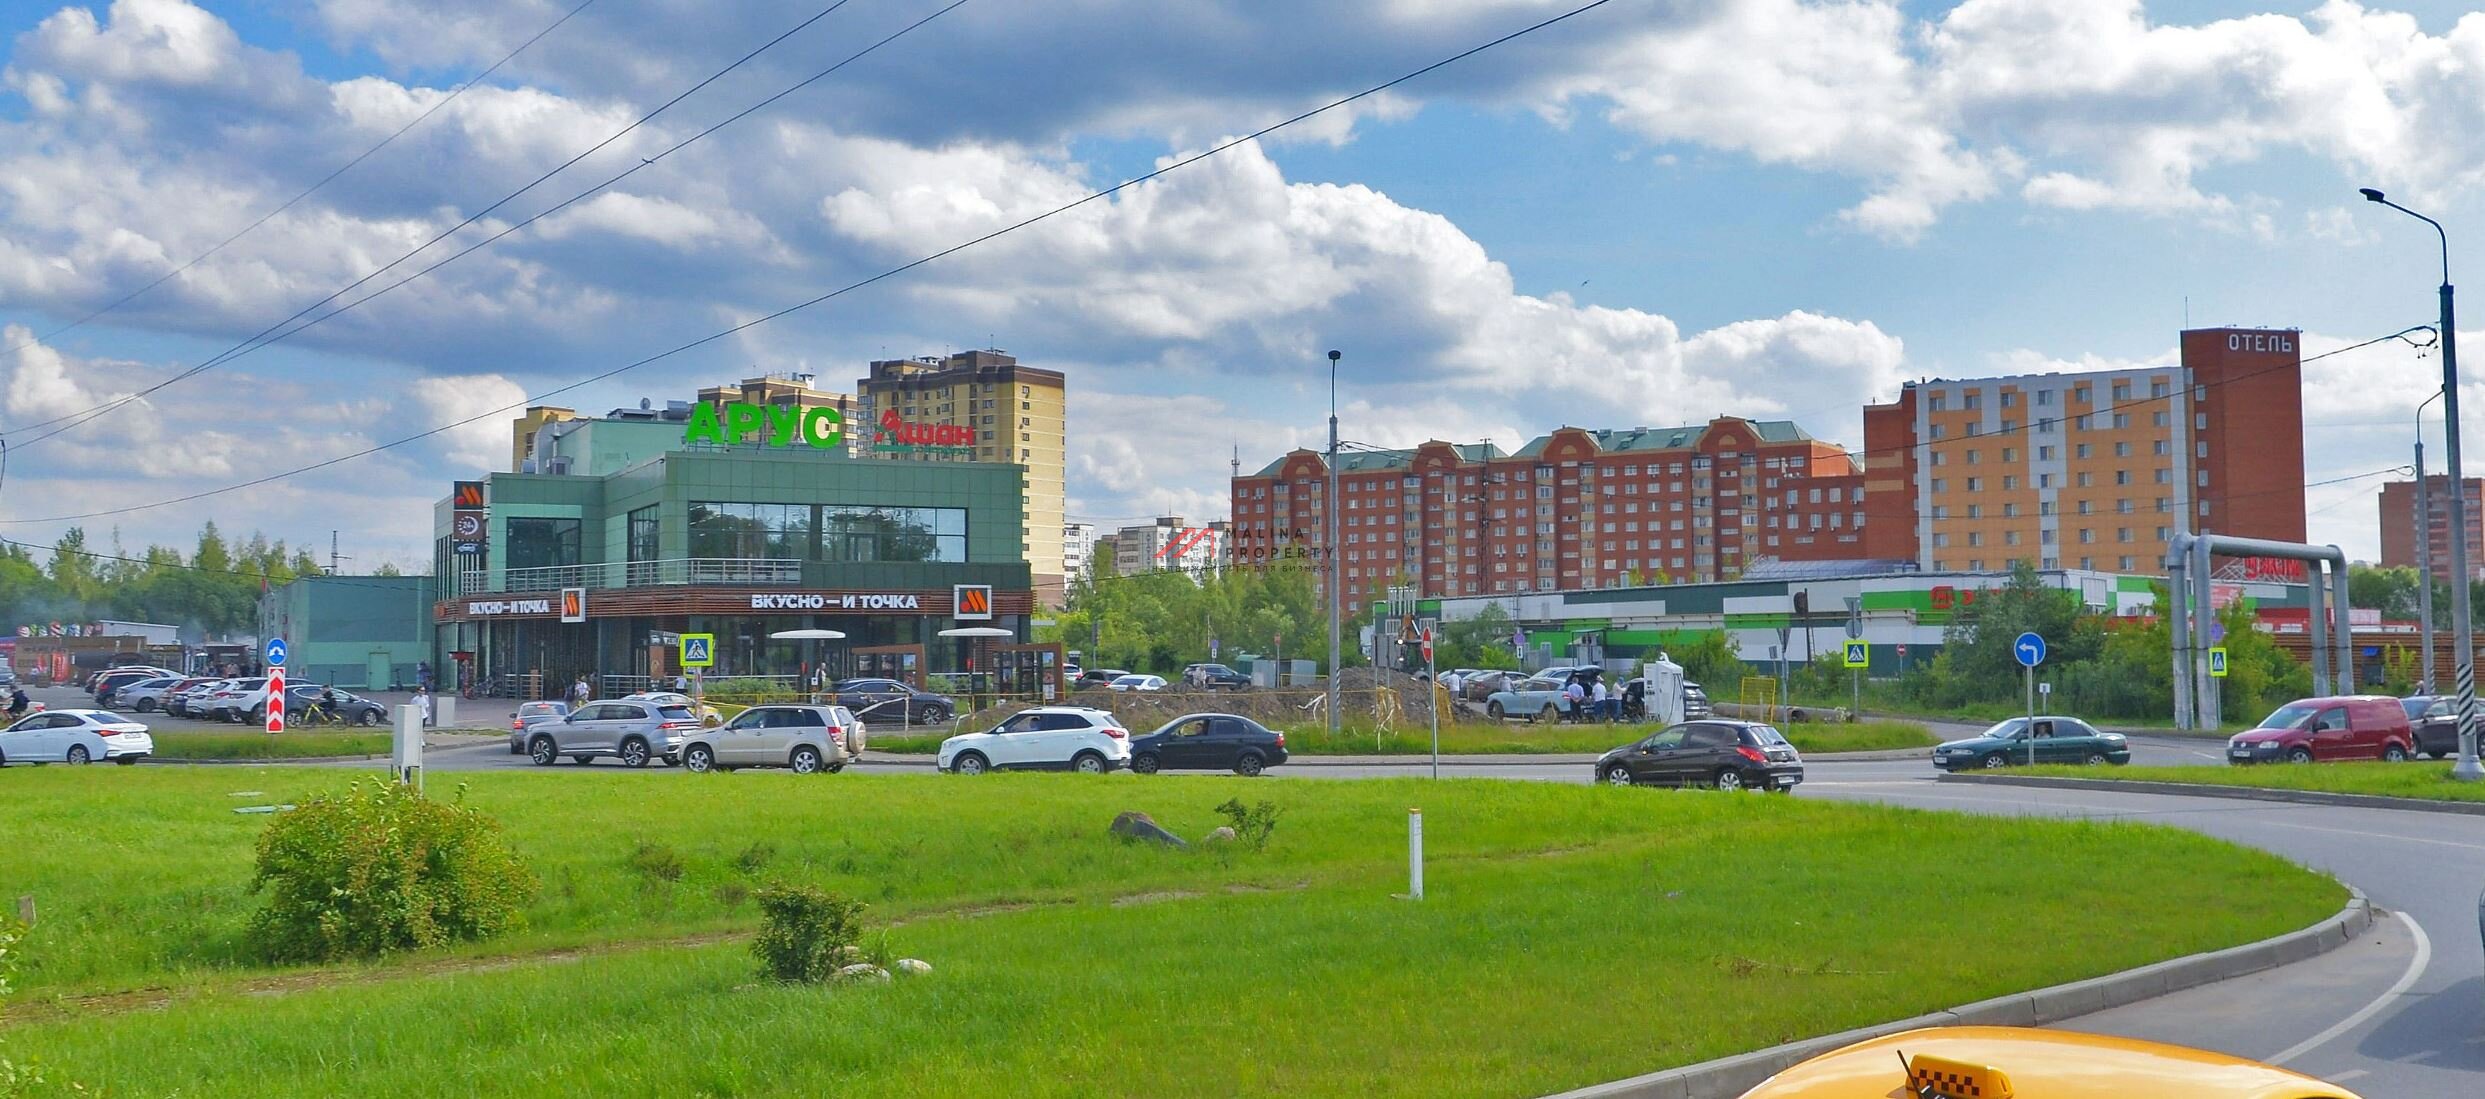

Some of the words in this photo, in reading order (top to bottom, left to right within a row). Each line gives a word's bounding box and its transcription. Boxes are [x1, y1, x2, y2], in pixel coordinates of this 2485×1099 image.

[2228, 334, 2293, 353] ОТЕЛЬ
[686, 400, 842, 449] АРУС
[469, 602, 503, 615] ВКУСНО
[519, 600, 550, 613] ТОЧКА
[751, 594, 824, 609] ВКУСНО
[859, 594, 919, 609] ТОЧКА
